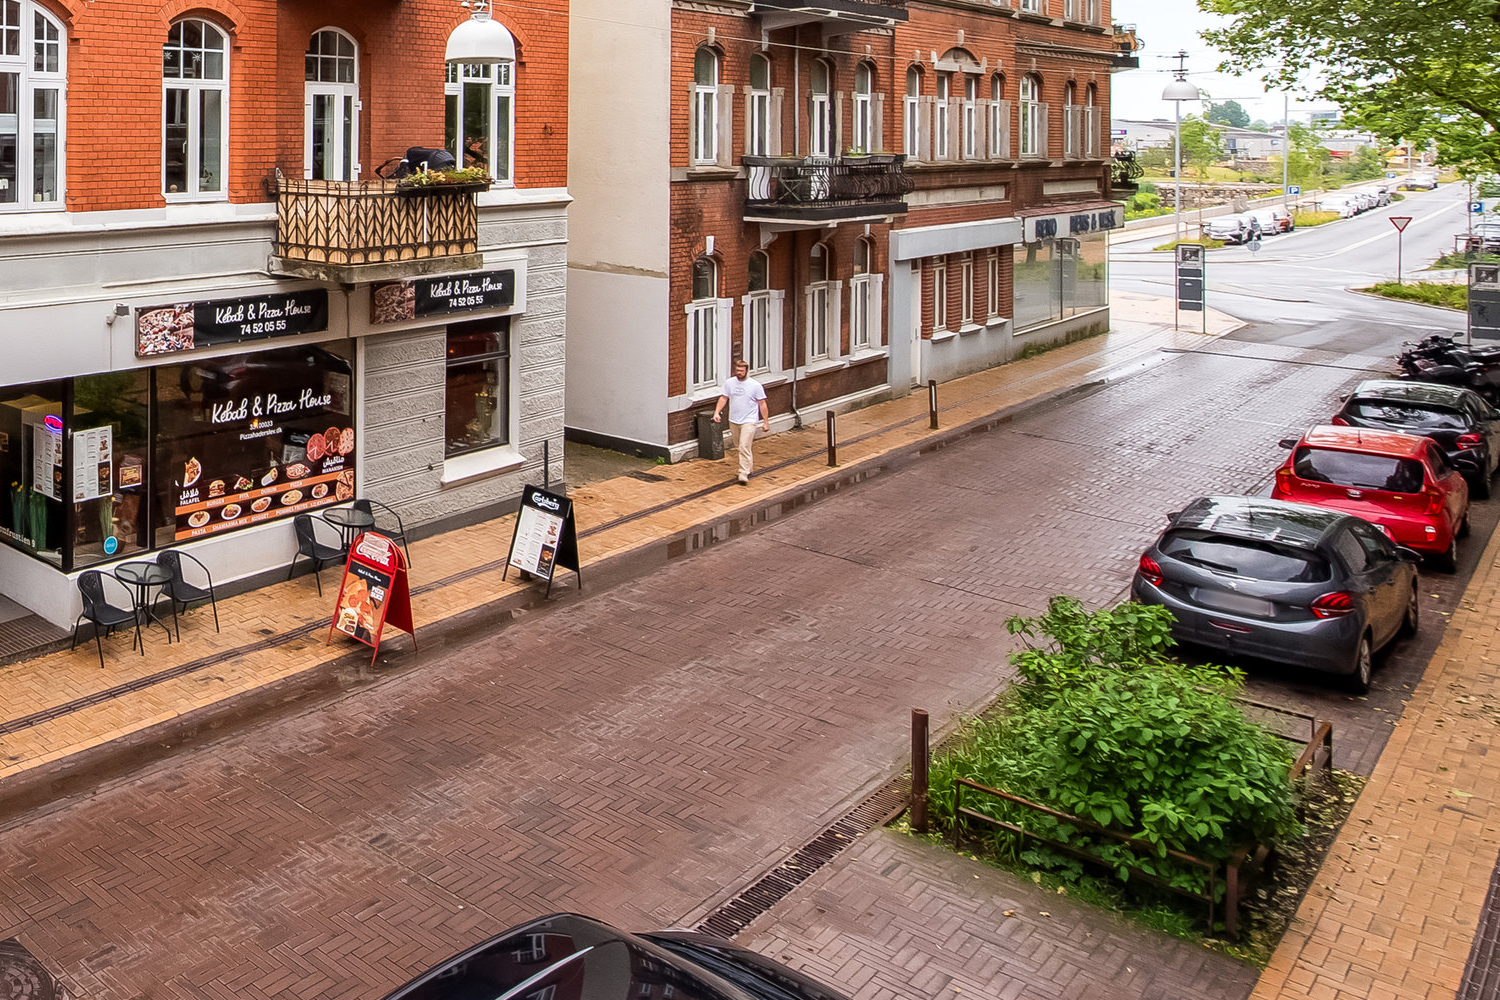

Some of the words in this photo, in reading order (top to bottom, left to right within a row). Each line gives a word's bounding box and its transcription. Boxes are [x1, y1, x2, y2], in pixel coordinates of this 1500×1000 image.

[429, 281, 453, 298] Kebab
[453, 280, 461, 295] &
[462, 279, 482, 294] Pizza
[481, 277, 503, 292] House
[448, 298, 458, 308] 74
[458, 297, 467, 307] 52
[466, 296, 475, 306] 05
[475, 295, 484, 304] 55
[215, 304, 245, 325] Kebab
[247, 303, 256, 320] &
[258, 302, 284, 319] Pizza
[284, 299, 312, 317] House
[240, 324, 251, 336] 74
[252, 322, 264, 334] 52
[264, 321, 275, 332] 05
[275, 320, 287, 331] 55
[211, 397, 249, 424] Kebab
[252, 396, 263, 417] &
[266, 393, 297, 415] Pizza
[298, 388, 332, 410] House
[532, 491, 560, 511] Carlsberg
[31, 539, 36, 548] 9
